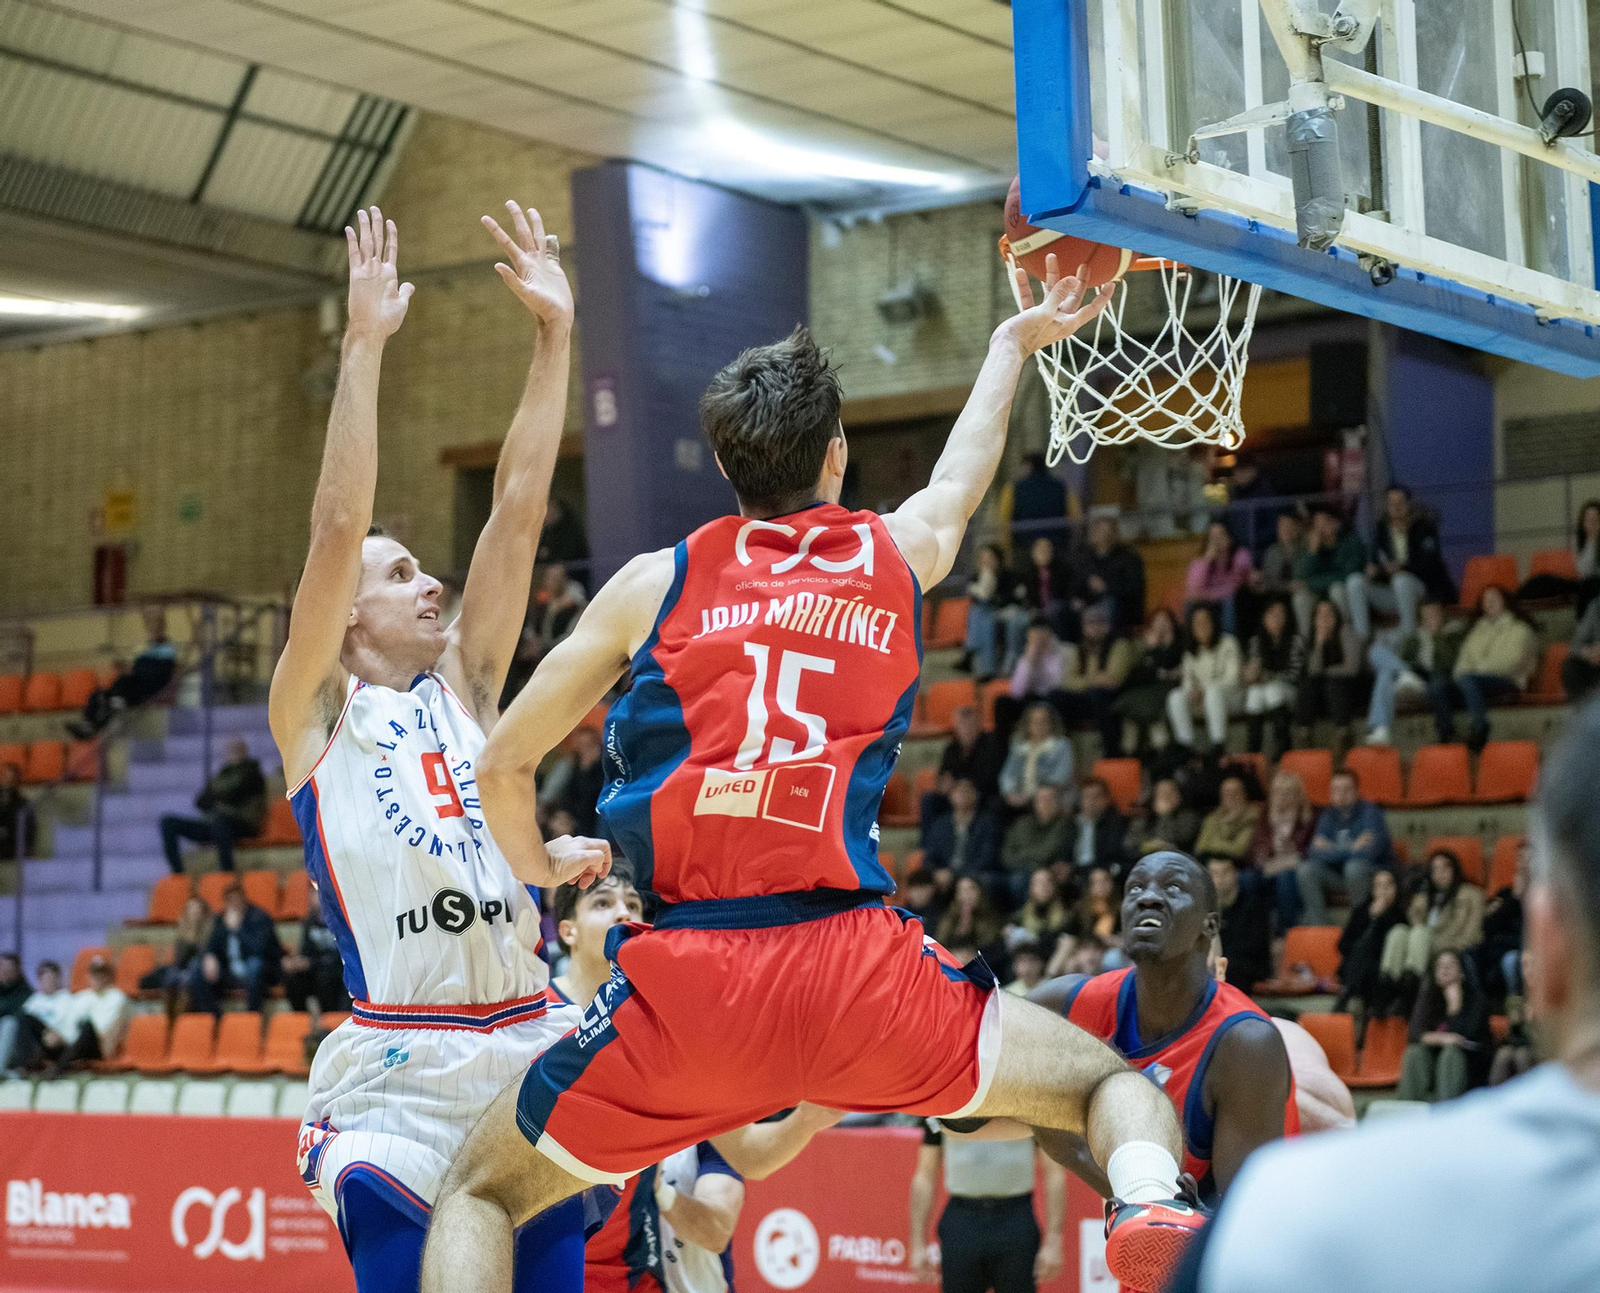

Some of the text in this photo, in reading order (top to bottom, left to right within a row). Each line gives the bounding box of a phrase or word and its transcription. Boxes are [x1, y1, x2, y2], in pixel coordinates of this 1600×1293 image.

[735, 576, 872, 591] oficina de servicios agrícolas
[765, 592, 898, 654] MARTÍNEZ
[733, 641, 836, 771] 15
[420, 752, 465, 819] 9
[7, 1178, 131, 1229] Blanca
[828, 1235, 906, 1265] PABLO
